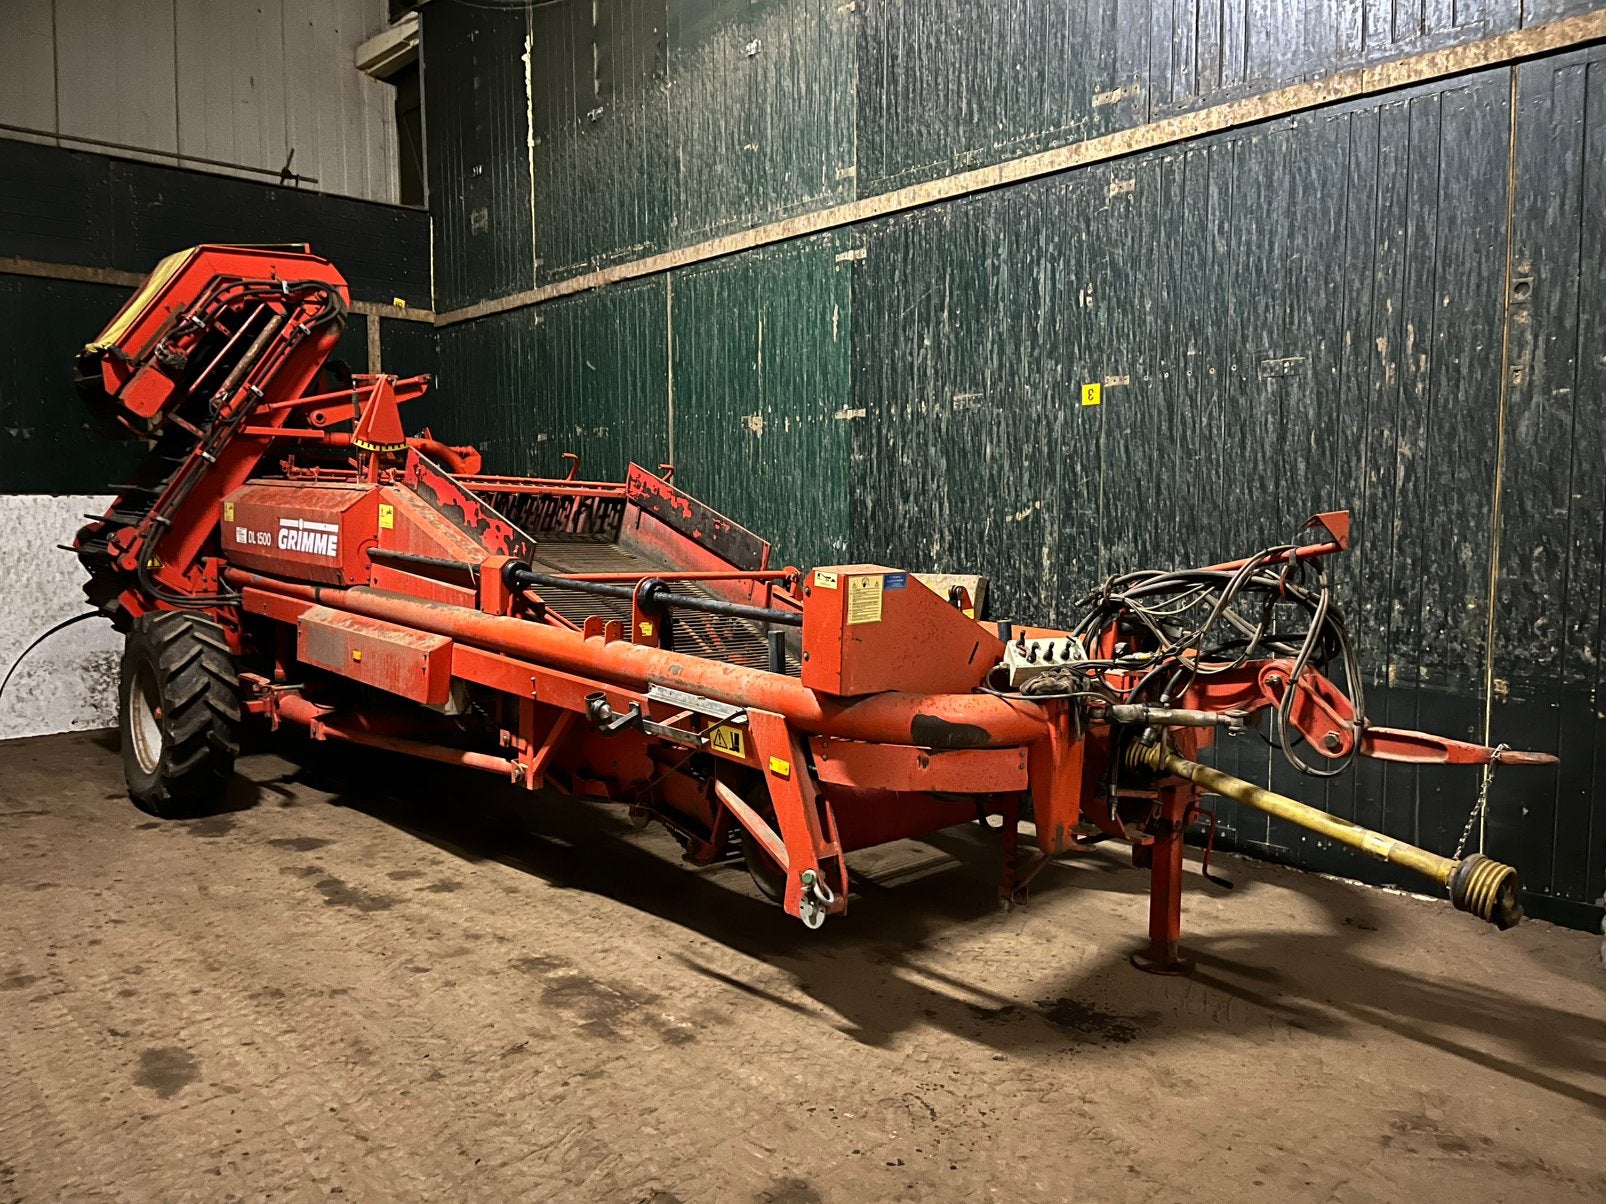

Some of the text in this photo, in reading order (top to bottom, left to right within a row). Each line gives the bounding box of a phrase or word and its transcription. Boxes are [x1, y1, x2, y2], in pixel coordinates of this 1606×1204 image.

[248, 530, 256, 544] DL
[257, 531, 272, 546] 1500
[278, 527, 338, 557] GRIMME
